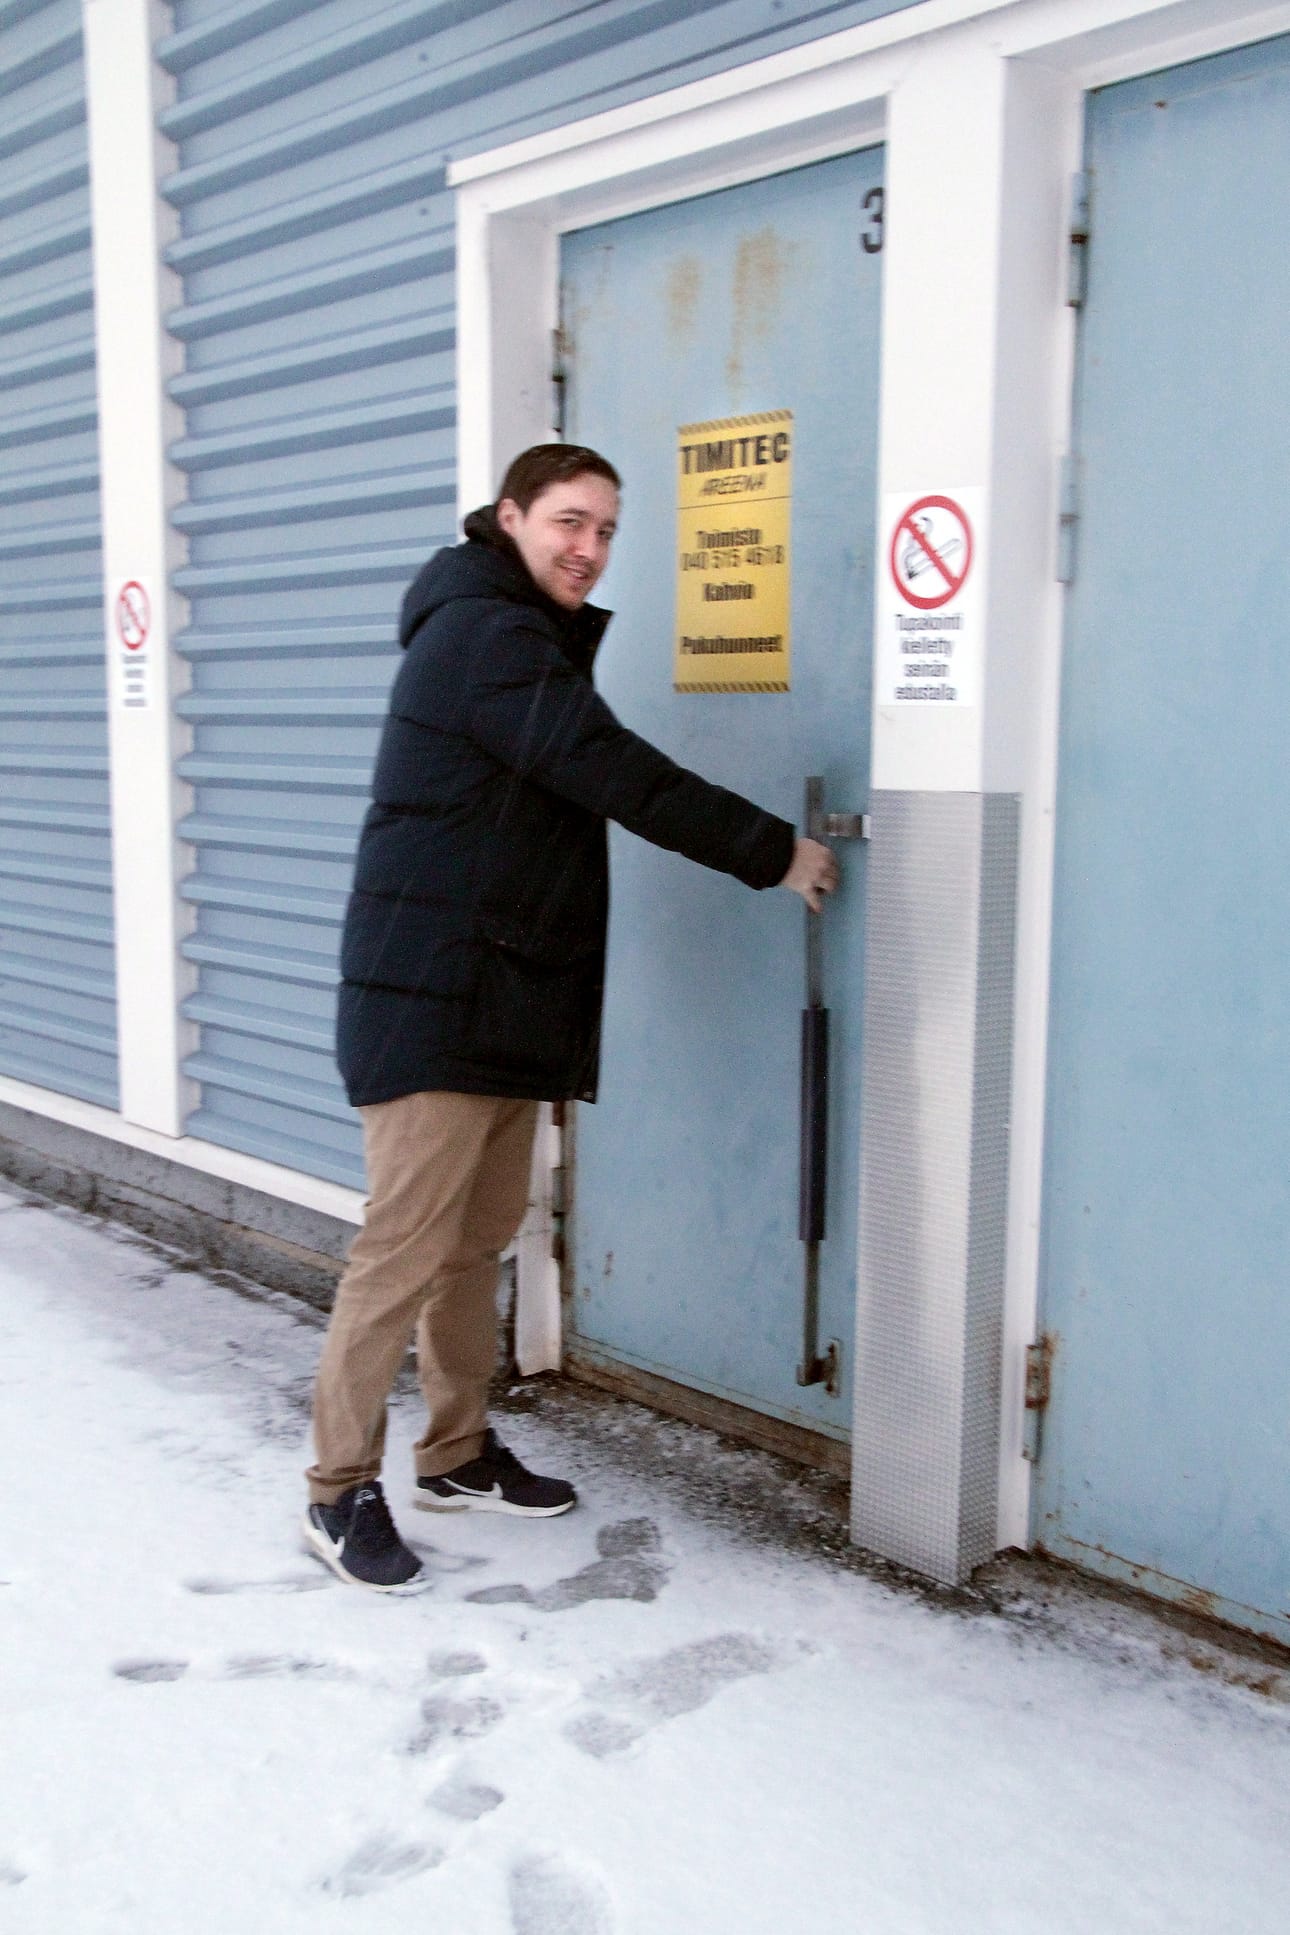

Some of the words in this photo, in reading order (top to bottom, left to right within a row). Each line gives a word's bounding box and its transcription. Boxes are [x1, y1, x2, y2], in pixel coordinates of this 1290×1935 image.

[862, 187, 884, 254] 3
[679, 432, 789, 474] TIMITEC
[896, 613, 963, 634] Tupakointi
[895, 683, 957, 700] edustalla
